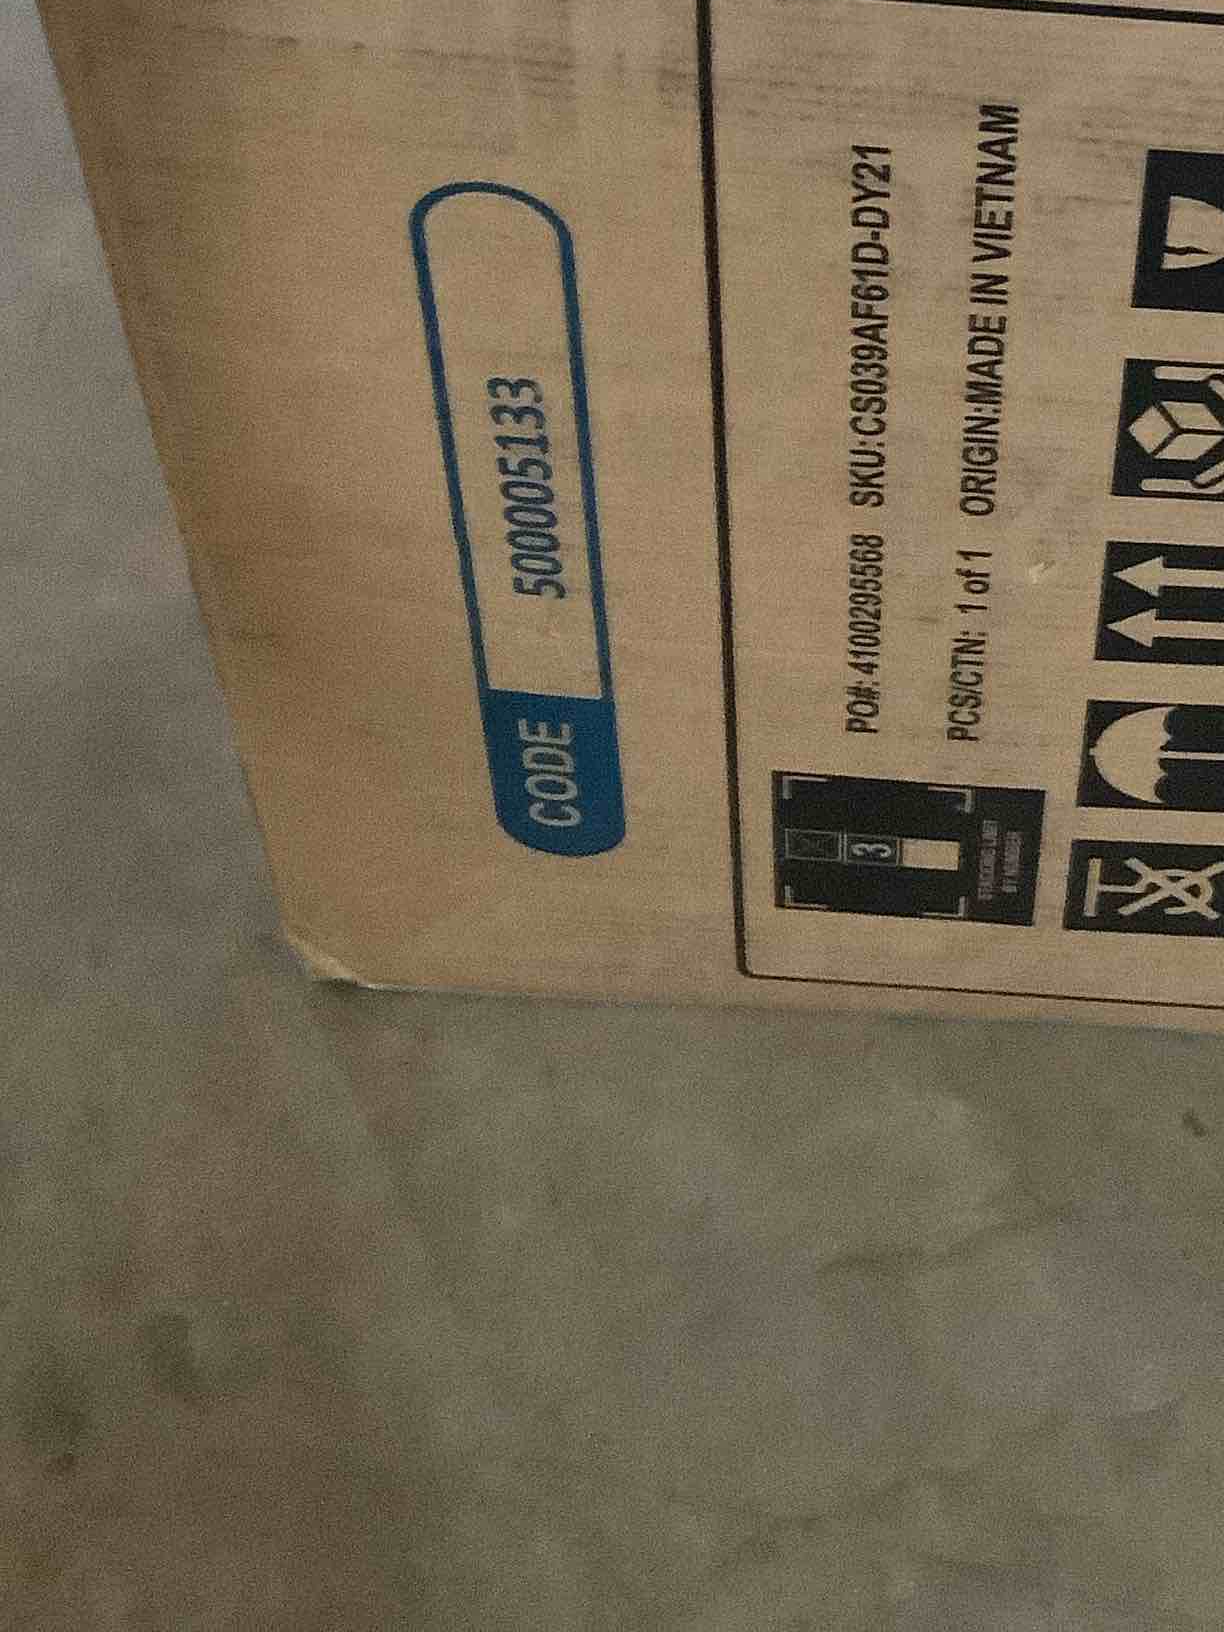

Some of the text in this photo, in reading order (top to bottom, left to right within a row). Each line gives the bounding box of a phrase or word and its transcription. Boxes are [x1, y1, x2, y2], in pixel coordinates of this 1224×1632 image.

[486, 376, 567, 601] 500005133
[845, 144, 893, 734] PO#: 4100295568 SKU:CS039AF61D-DY21
[946, 103, 1020, 742] PCS/CTN: 1 of 1 ORIGIN:MADE IN VIETNAM
[516, 716, 583, 827] CODE
[850, 842, 893, 859] 3
